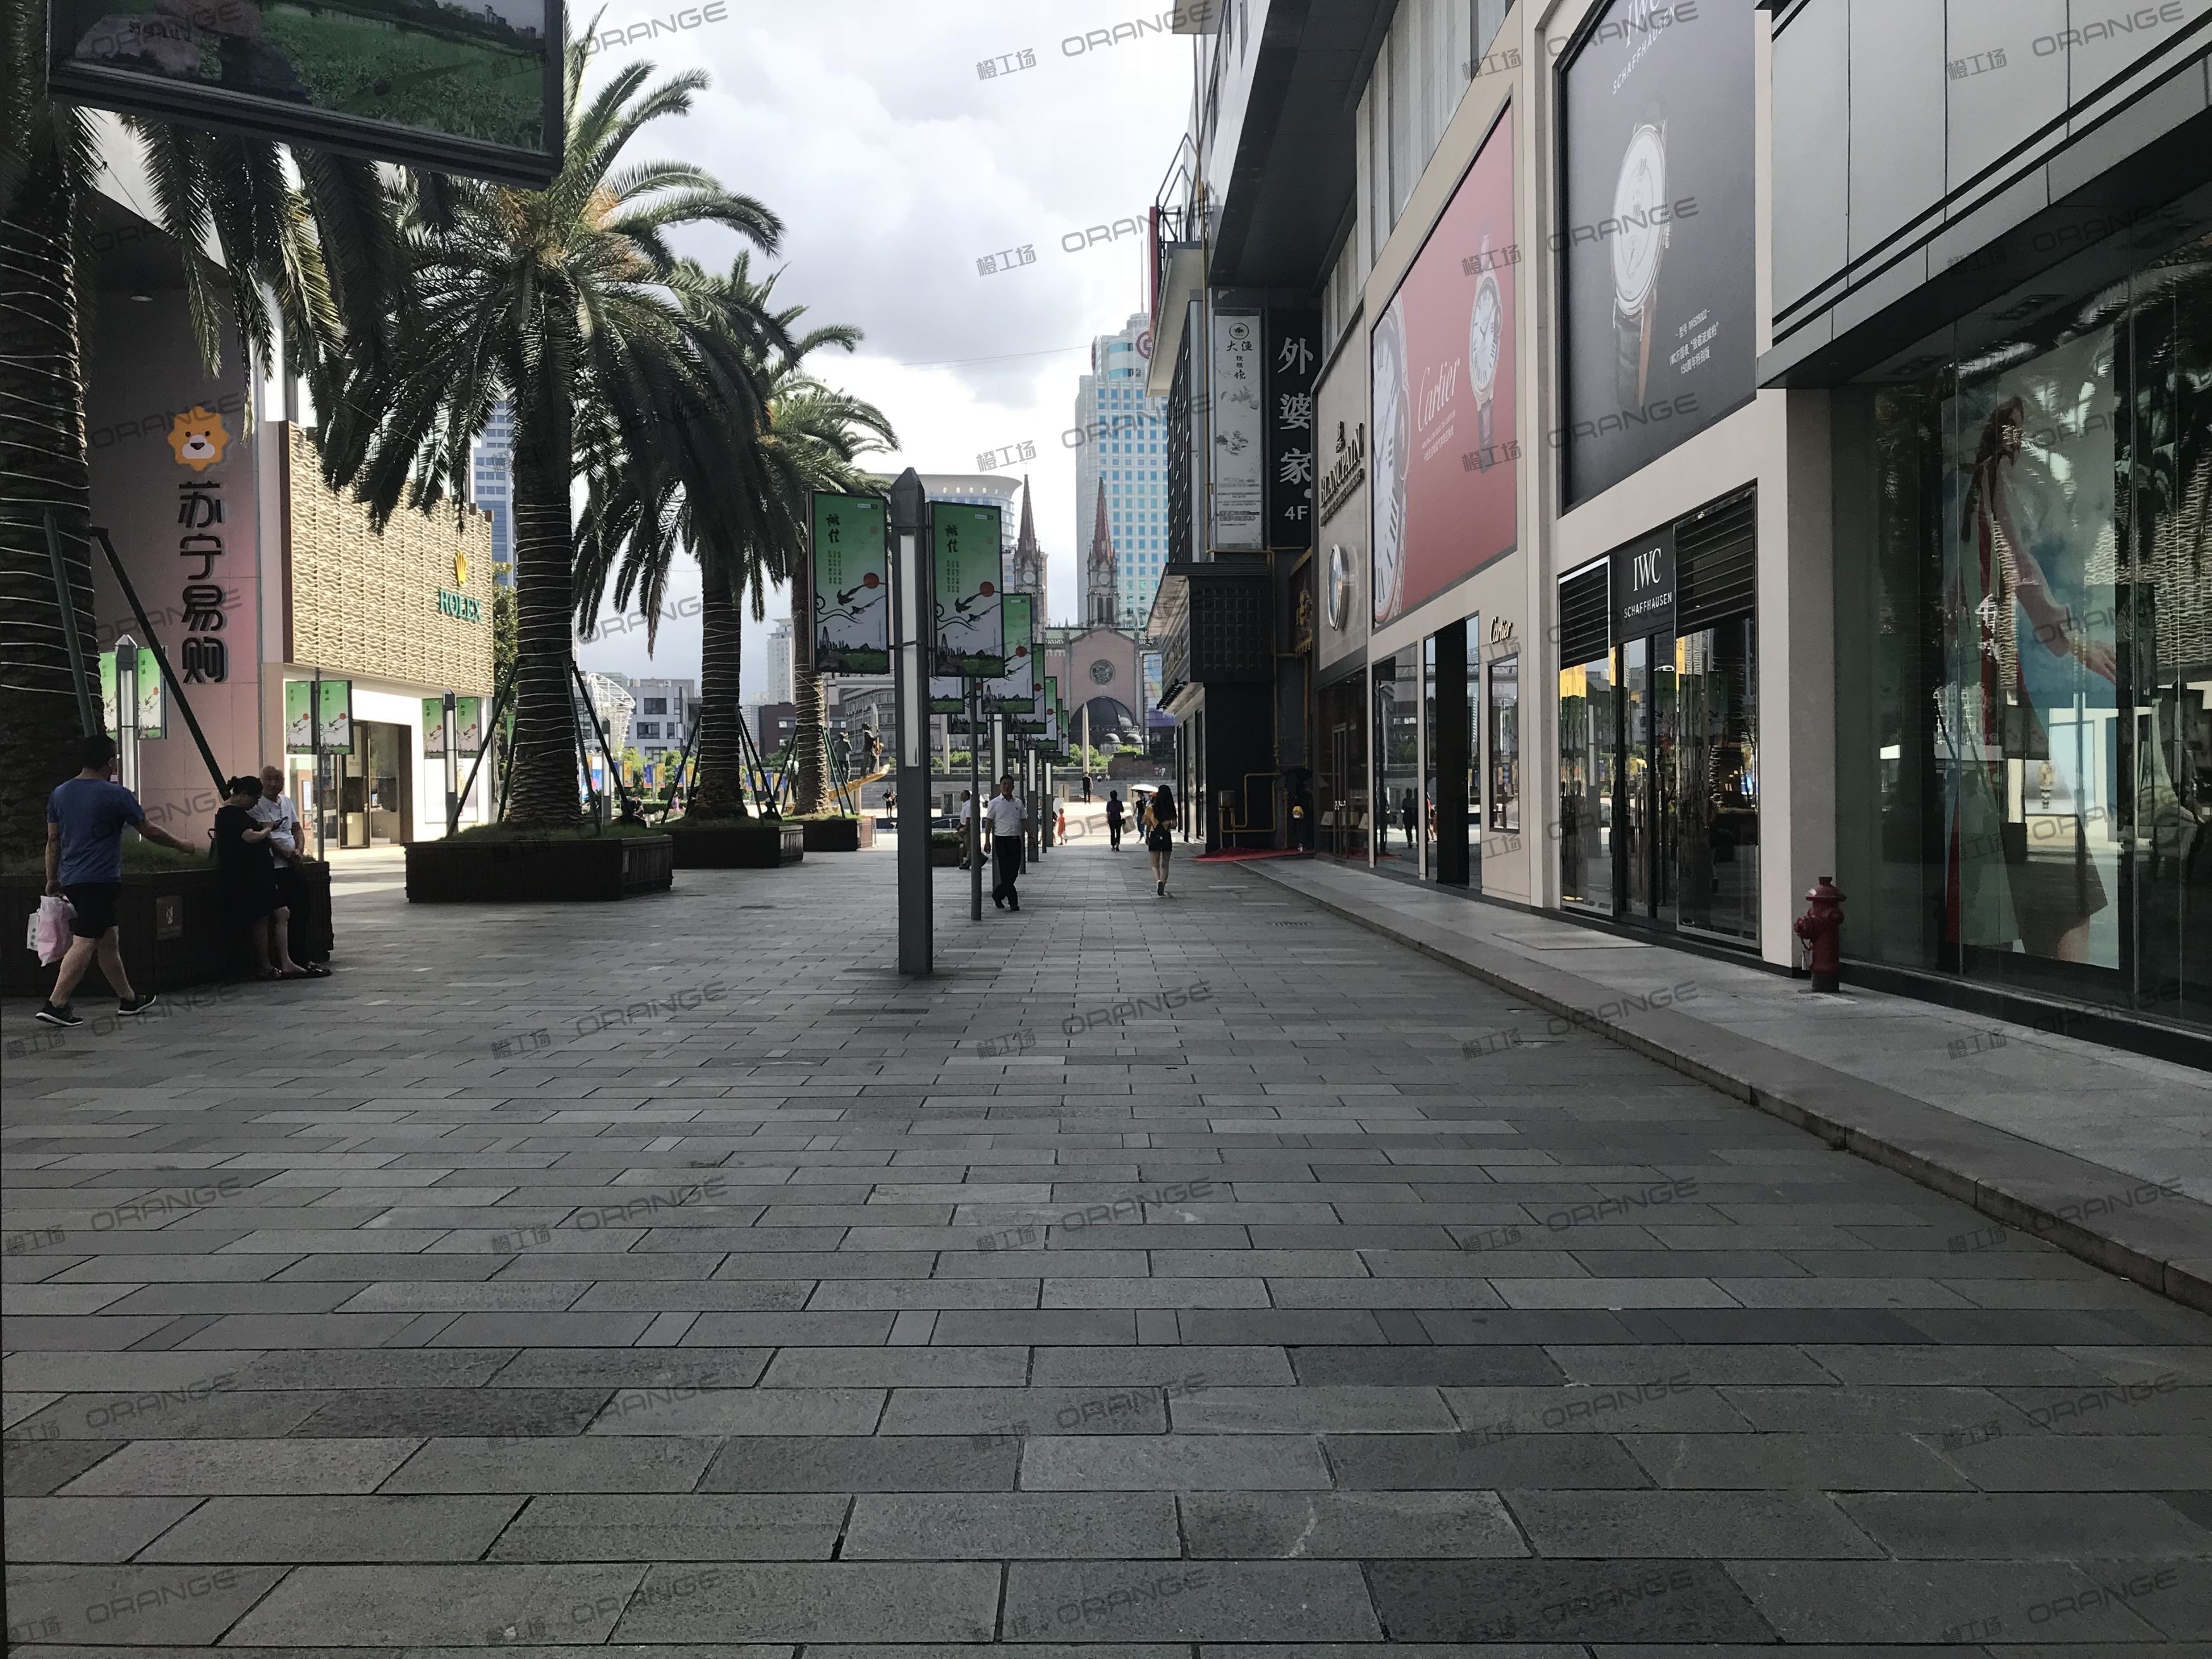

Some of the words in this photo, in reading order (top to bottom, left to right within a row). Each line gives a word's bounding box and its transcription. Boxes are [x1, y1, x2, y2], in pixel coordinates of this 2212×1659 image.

[1613, 2, 1675, 95] SCHAFFHAUSEN
[1626, 0, 1660, 49] IW
[1277, 337, 1314, 485] 外婆家
[1418, 357, 1461, 432] Cartier
[1320, 422, 1365, 508] BLANCPAIN
[1284, 506, 1308, 521] 4F
[178, 480, 226, 683] 苏宁易购
[1634, 547, 1662, 591] IWC
[439, 588, 483, 622] ROLEX
[1624, 592, 1672, 619] SCHAFFHAUSEN
[1490, 616, 1512, 644] Cartier
